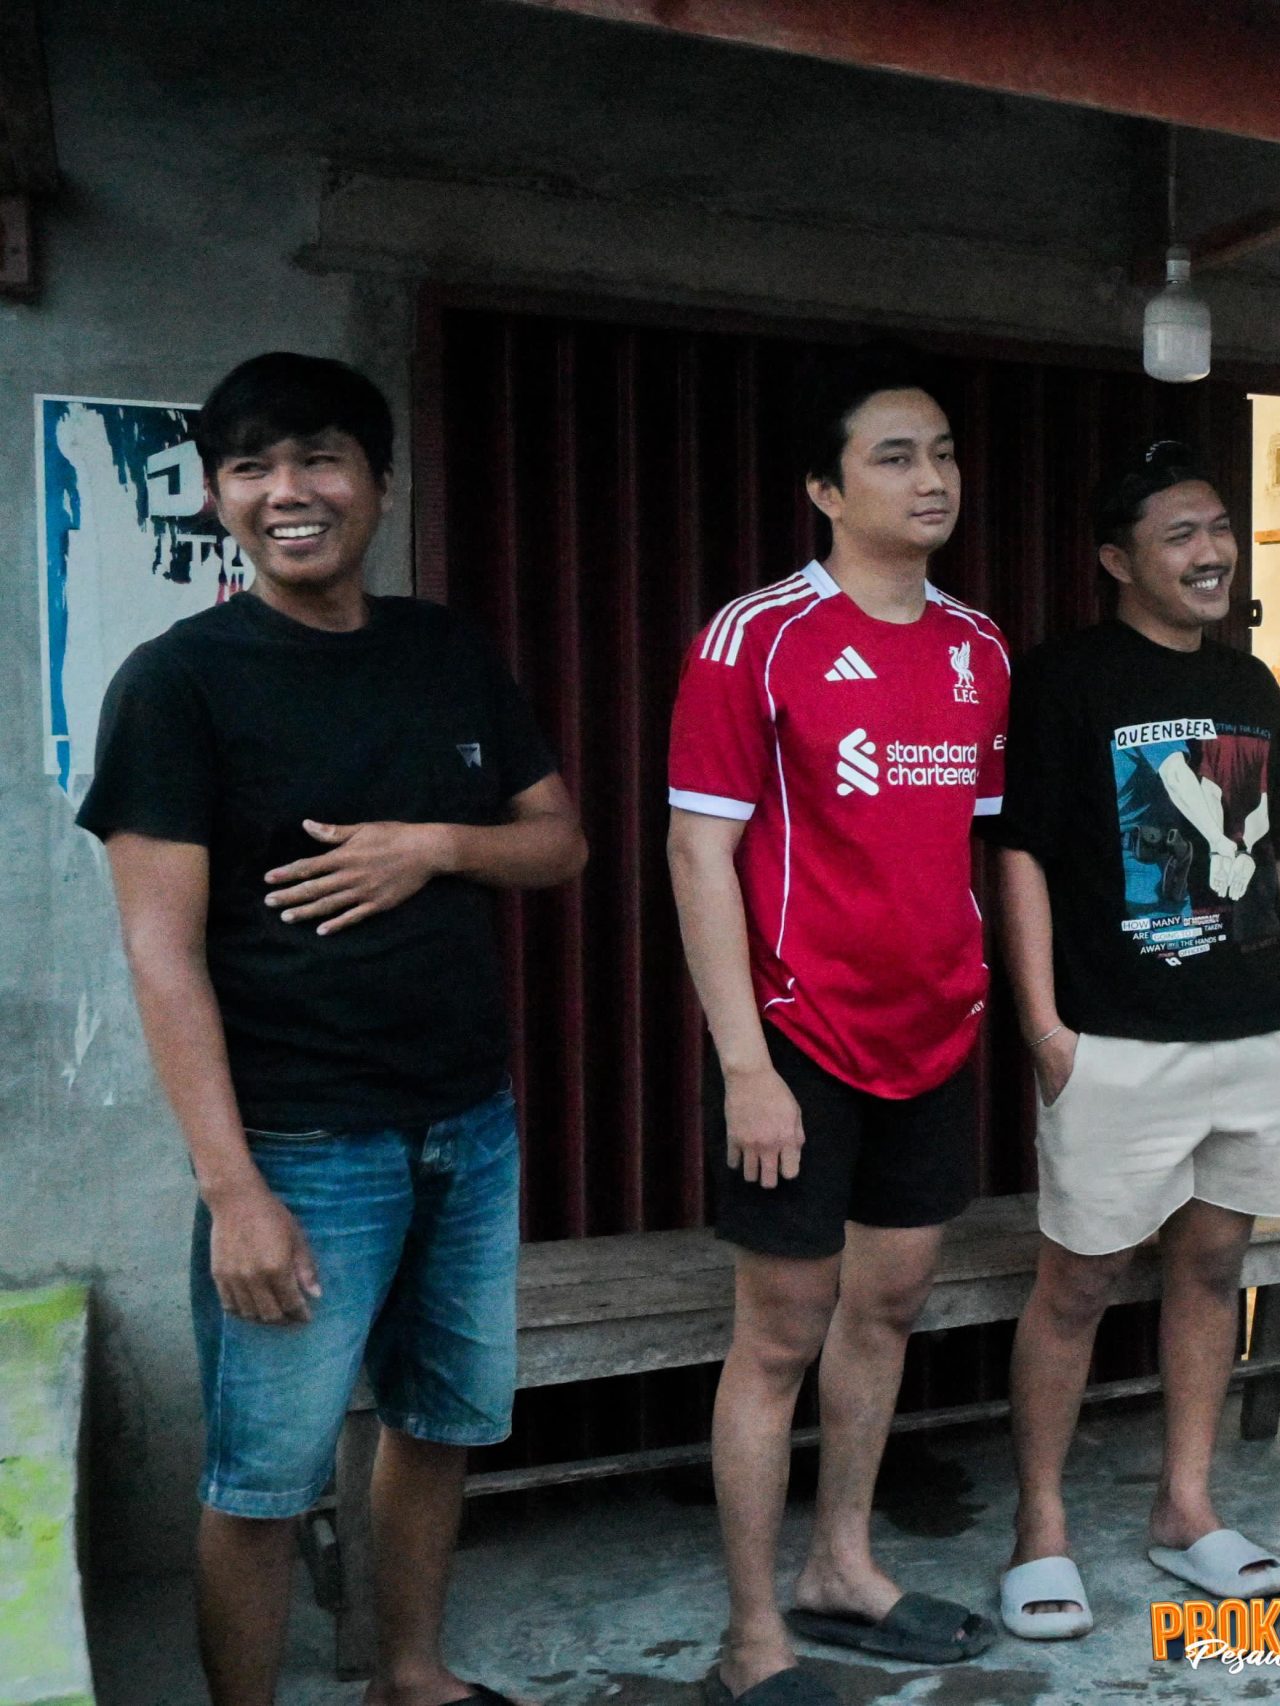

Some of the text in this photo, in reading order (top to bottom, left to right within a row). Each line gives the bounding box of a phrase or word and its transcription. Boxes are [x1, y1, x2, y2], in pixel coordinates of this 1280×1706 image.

[886, 740, 978, 763] standard
[1123, 920, 1149, 930] HOW
[1152, 916, 1181, 928] MANY
[1132, 932, 1149, 941] ARE
[1140, 943, 1167, 955] AWAY
[1195, 936, 1218, 946] HANDS
